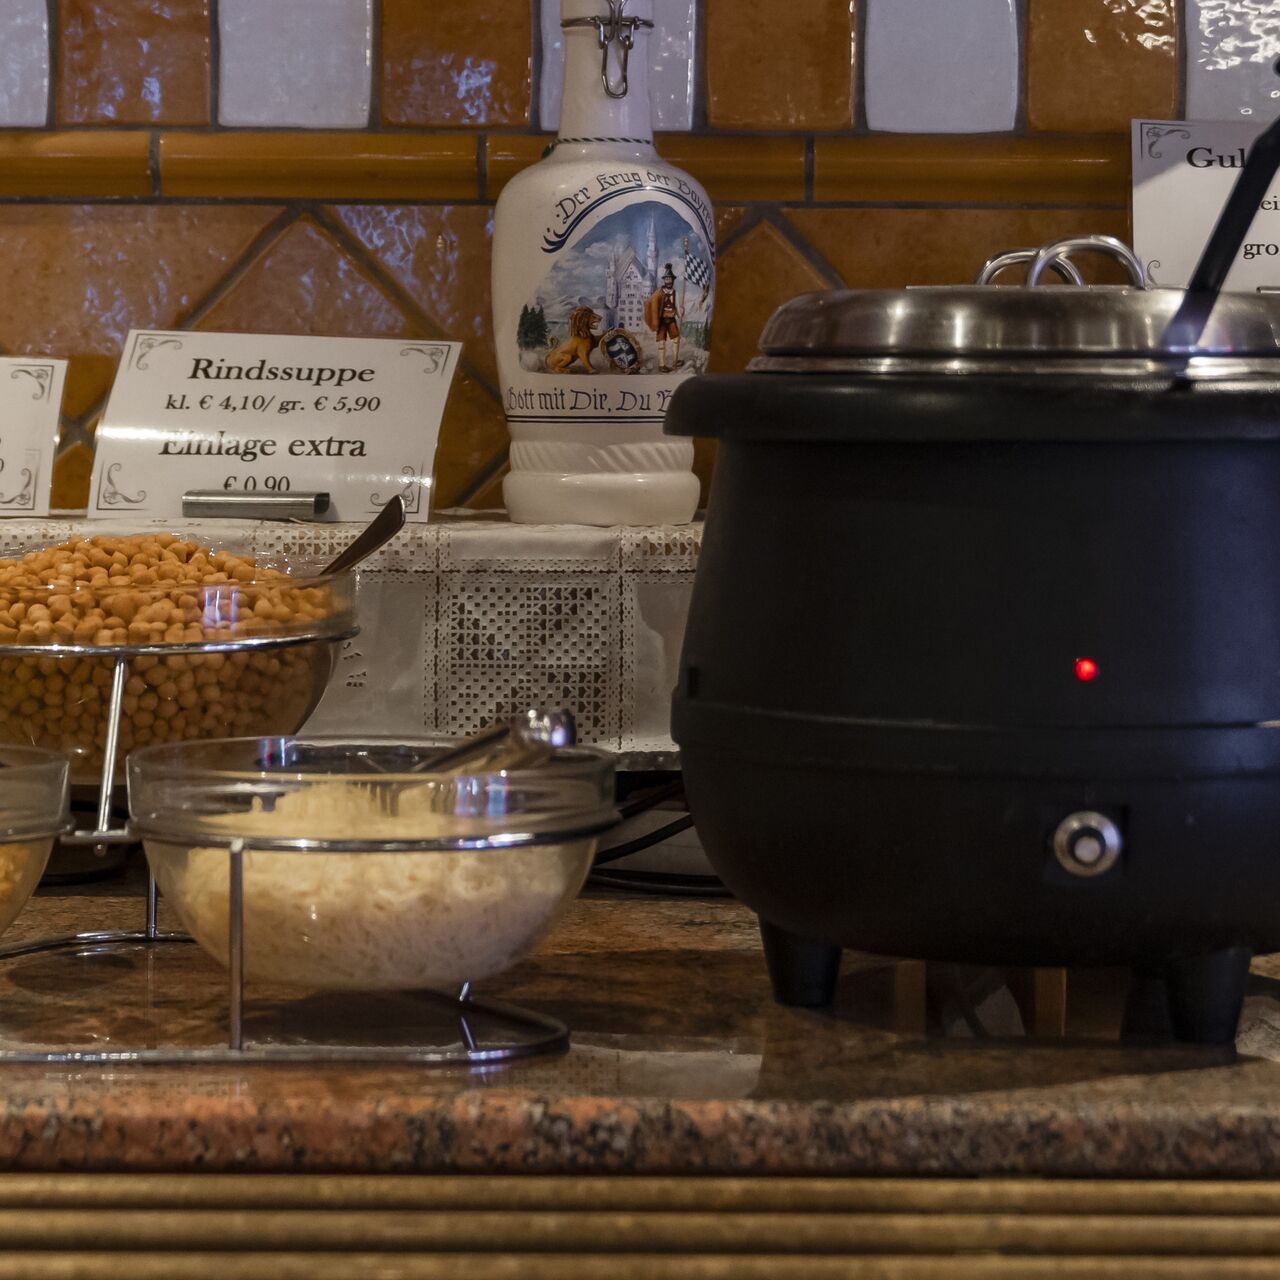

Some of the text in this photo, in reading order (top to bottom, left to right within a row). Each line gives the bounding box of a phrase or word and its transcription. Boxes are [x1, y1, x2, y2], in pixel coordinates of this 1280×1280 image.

[555, 186, 591, 224] Der
[187, 358, 376, 387] Rindssuppe
[164, 394, 381, 414] kl. € 4,10/ gr. € 5,90
[538, 387, 566, 410] mit
[615, 390, 652, 411] Du
[158, 430, 368, 462] Einlage extra
[243, 475, 291, 491] 090
